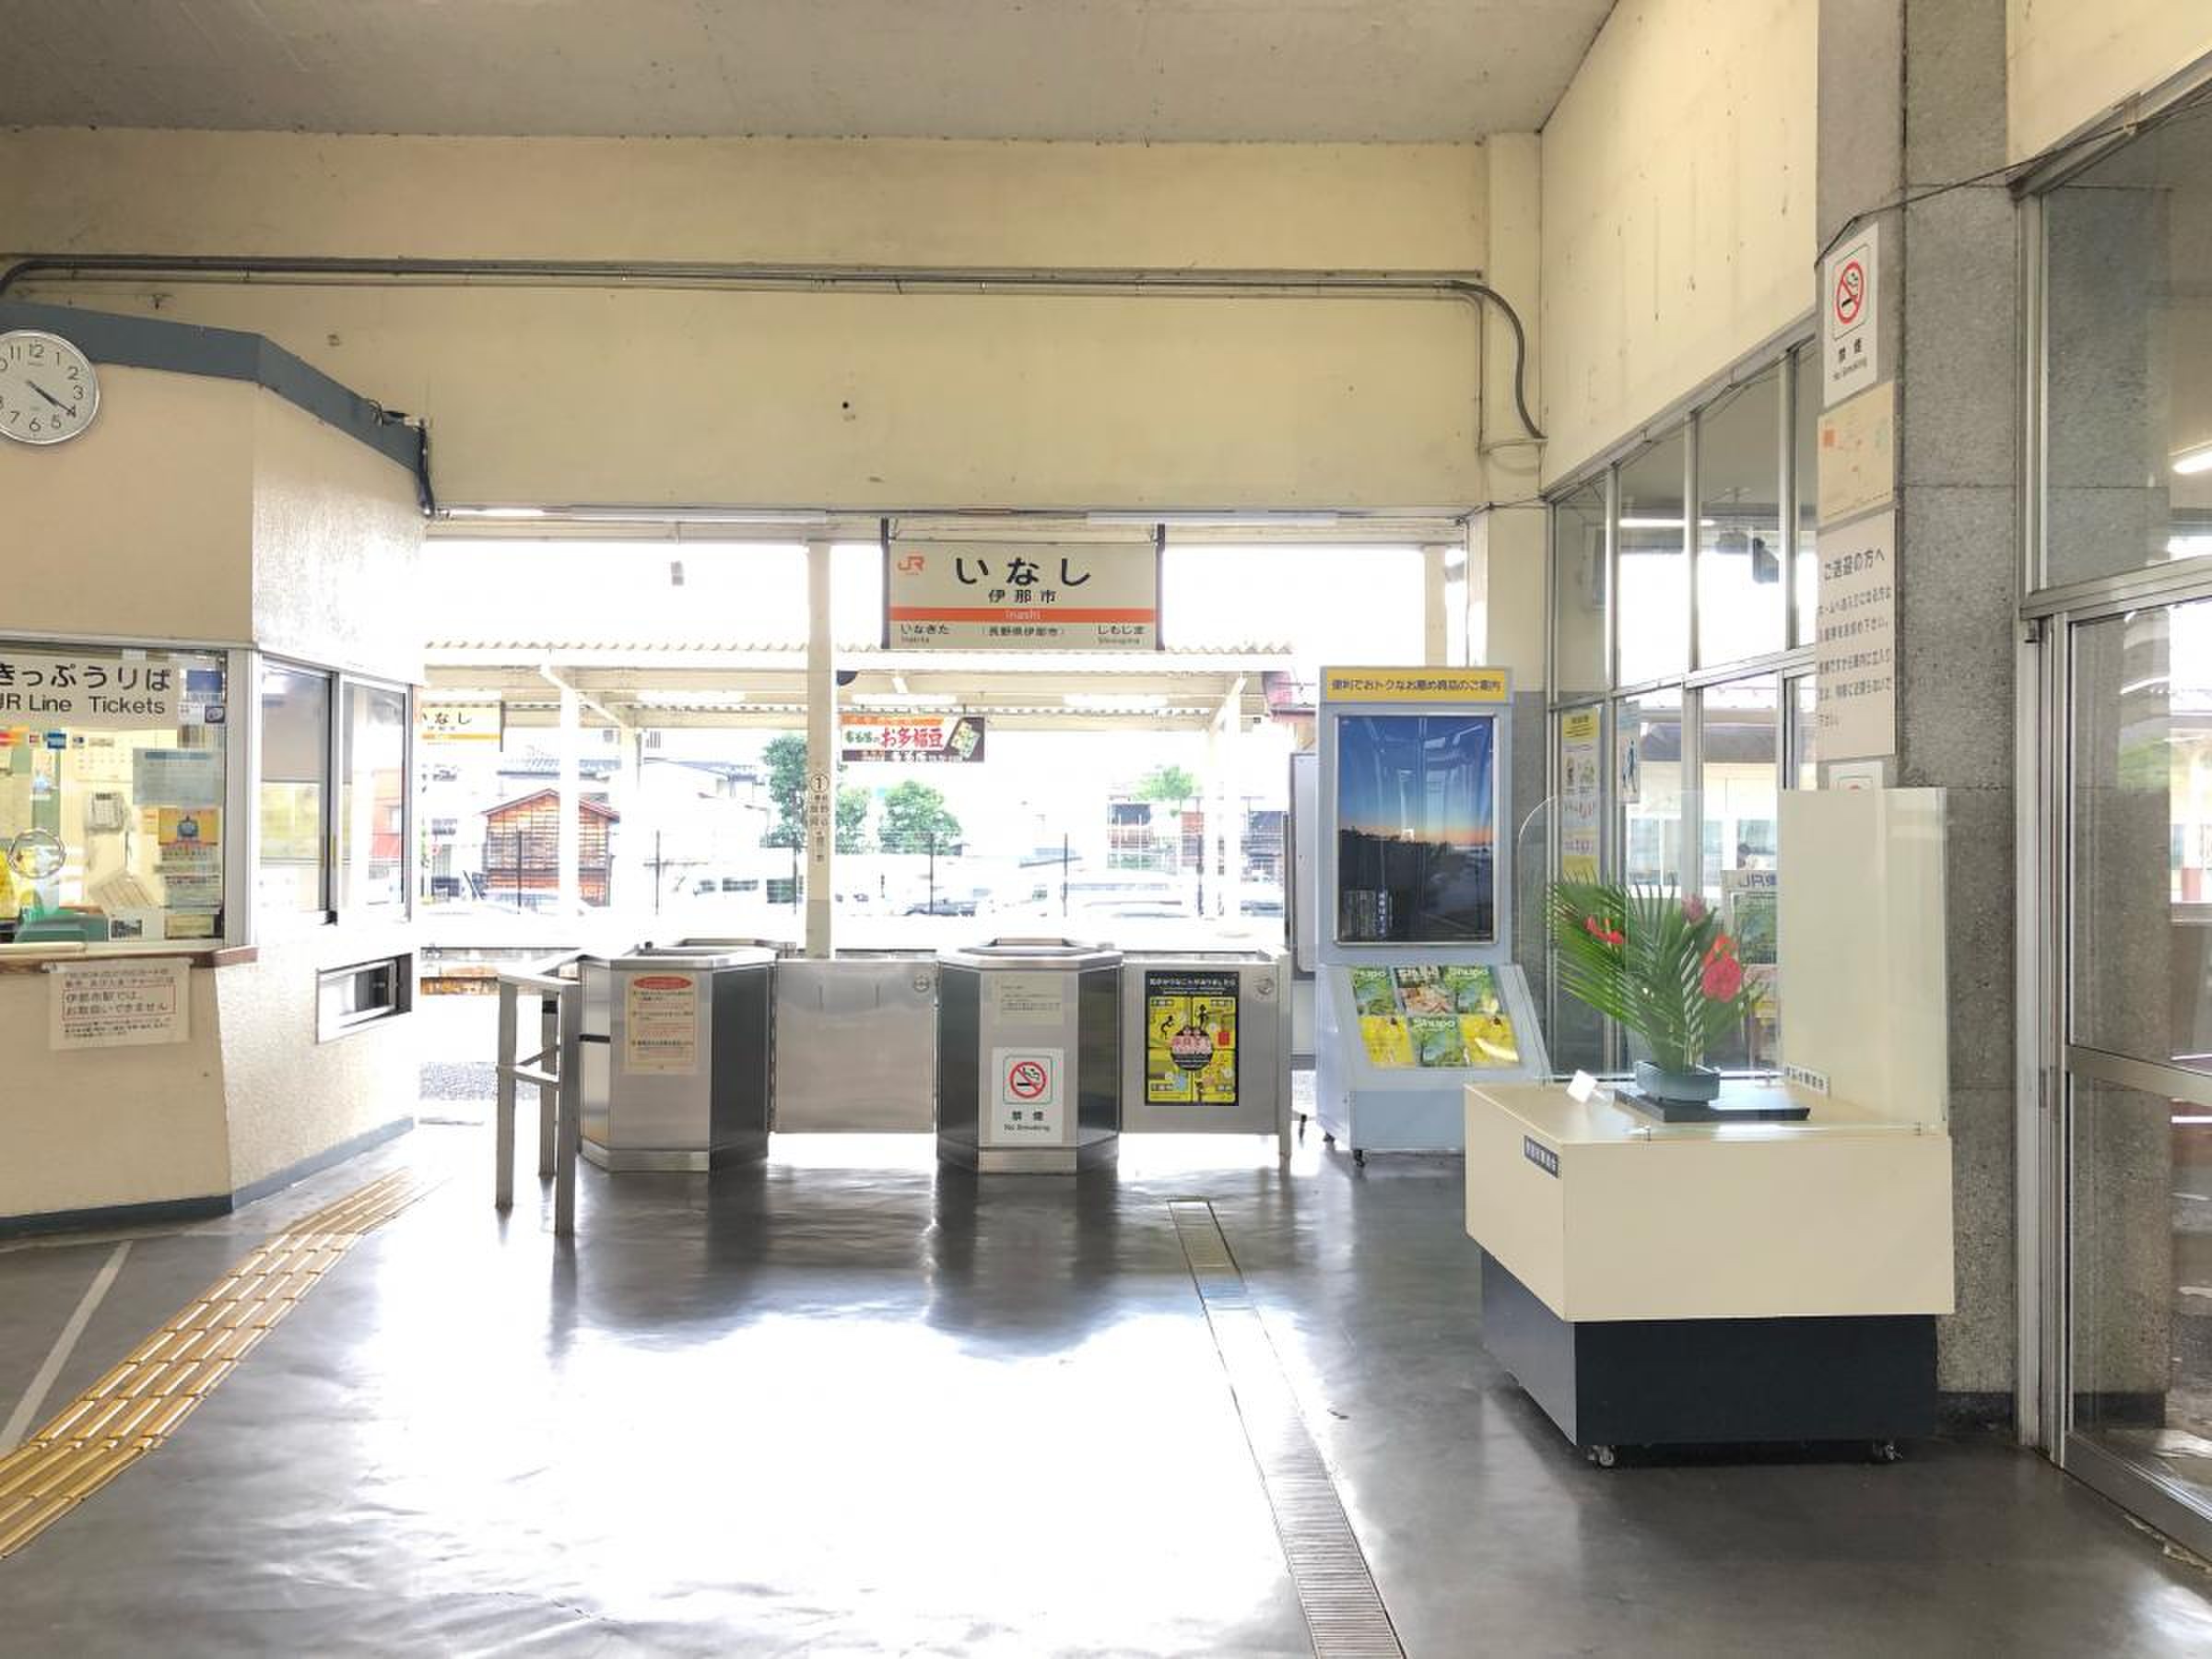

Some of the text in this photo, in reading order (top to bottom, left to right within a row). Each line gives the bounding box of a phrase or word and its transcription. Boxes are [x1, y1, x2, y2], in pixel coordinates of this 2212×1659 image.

[10, 346, 20, 360] 11
[29, 343, 44, 359] 12
[67, 366, 79, 381] 2
[73, 384, 84, 400] 3
[10, 410, 20, 424] 7
[51, 414, 61, 429] 5
[29, 418, 41, 432] 6
[898, 556, 925, 571] JR
[955, 557, 1091, 586] いなし
[988, 589, 1057, 605] 伊那市
[900, 624, 950, 635] いなきた
[1098, 624, 1144, 635] しもじま
[0, 662, 171, 691] きっぷうりば
[29, 694, 73, 712] Line
[88, 695, 166, 715] Tickets
